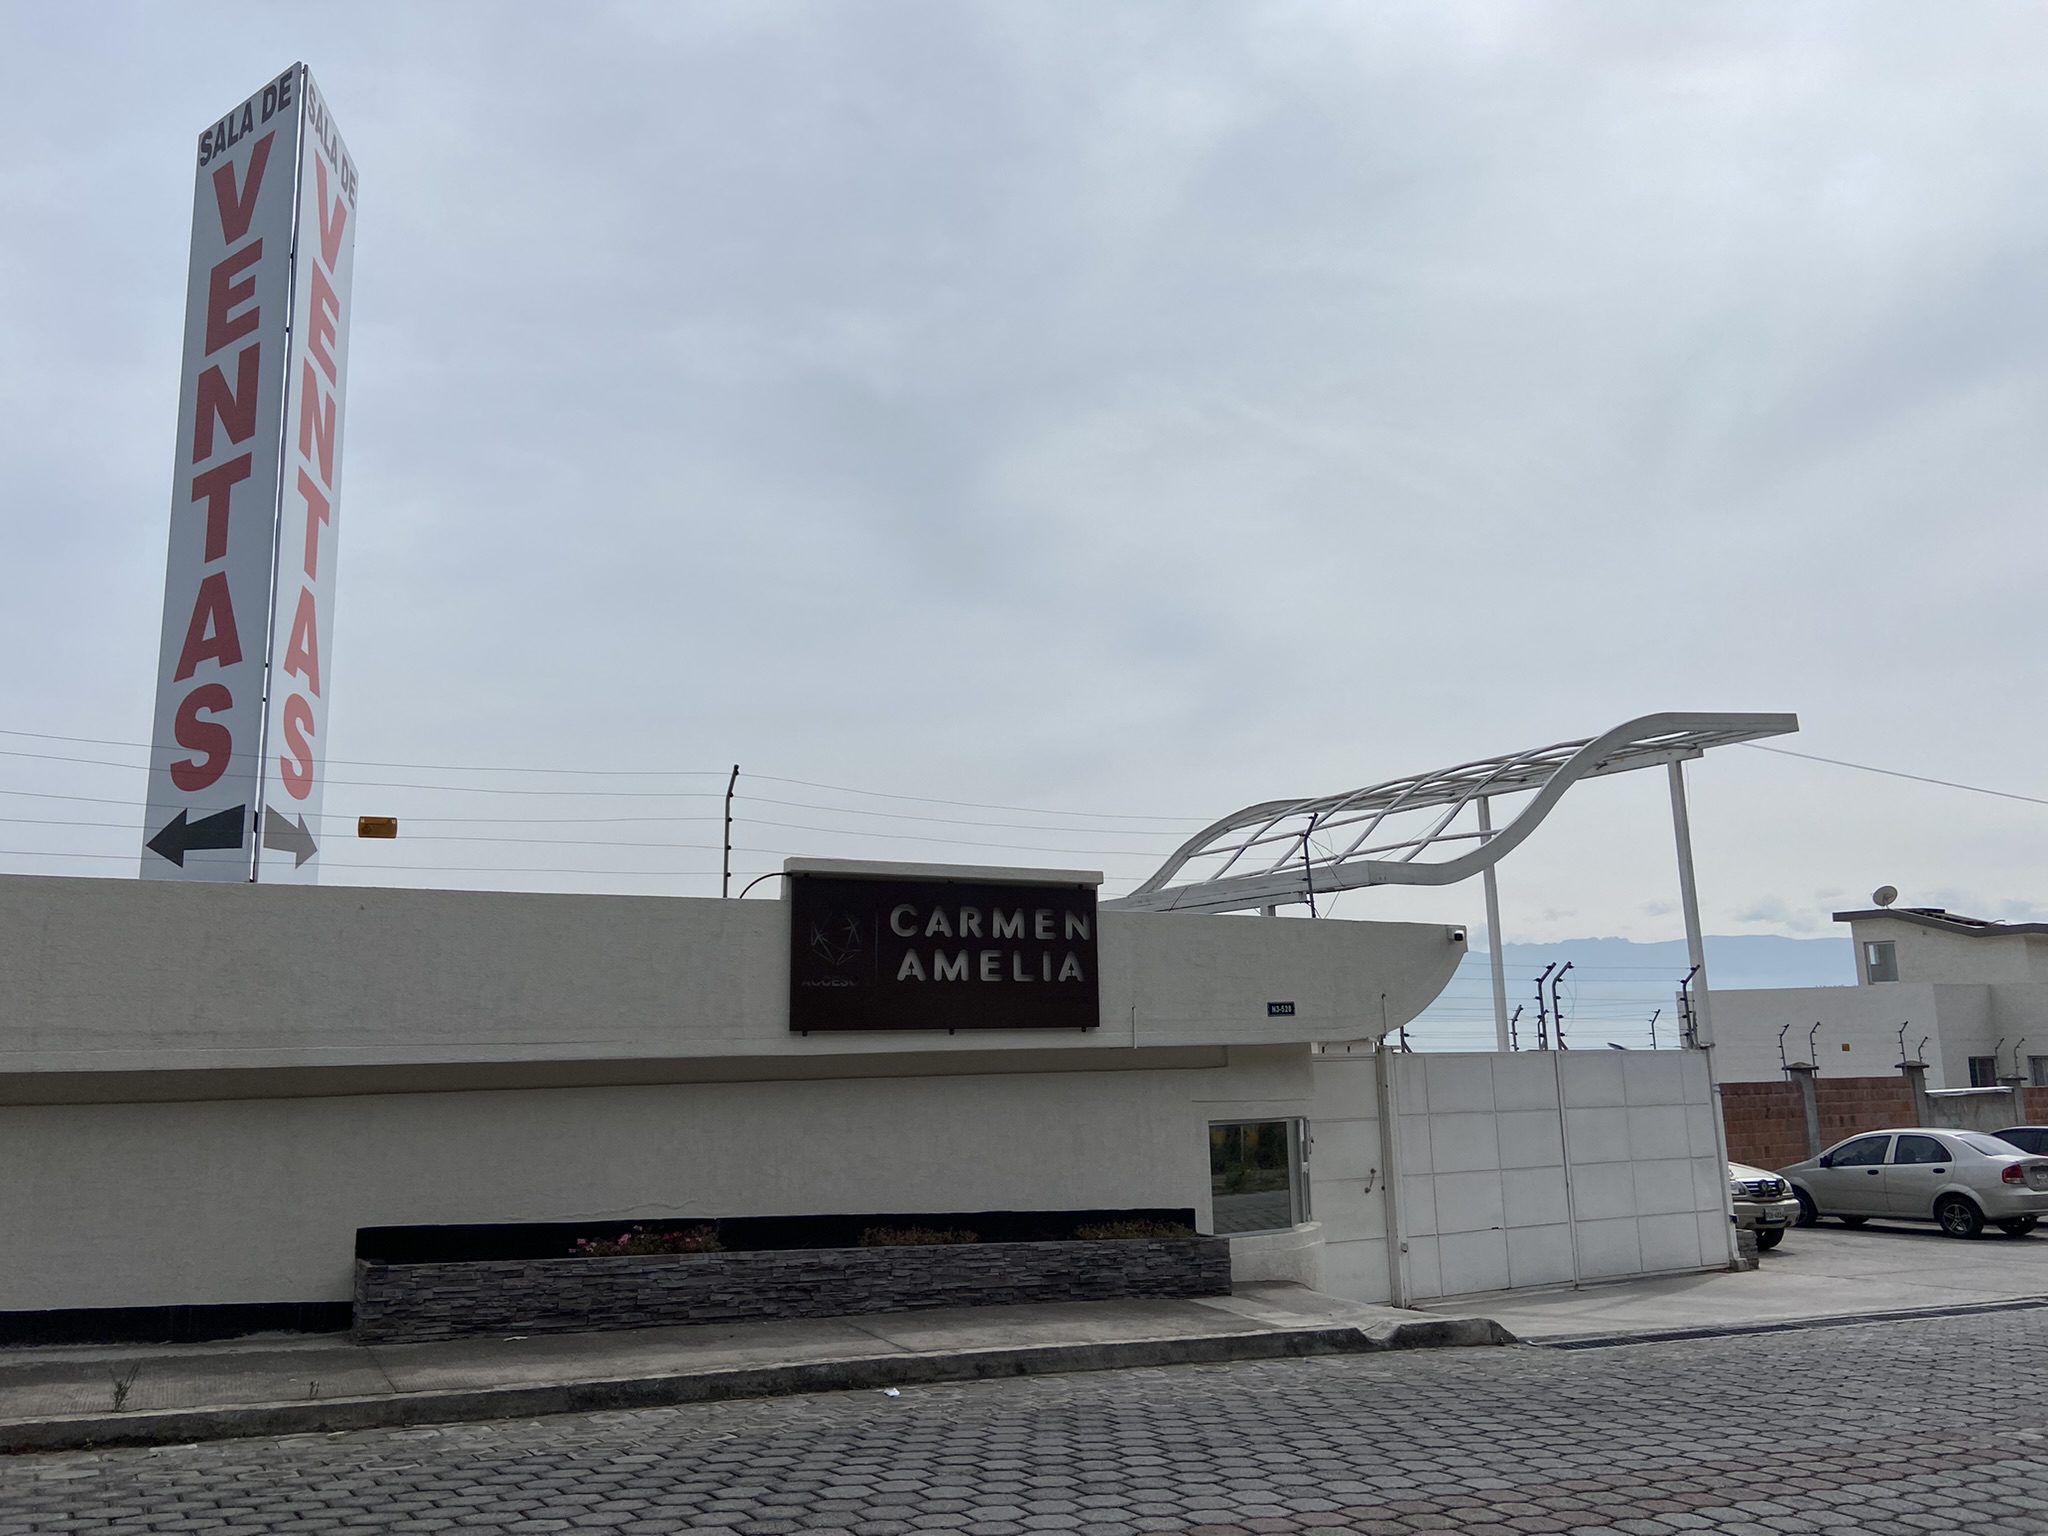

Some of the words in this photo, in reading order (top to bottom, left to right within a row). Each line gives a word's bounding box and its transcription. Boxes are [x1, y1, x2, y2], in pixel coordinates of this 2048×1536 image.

[200, 101, 253, 166] SALA
[262, 70, 293, 124] DE
[307, 84, 338, 174] SALA
[341, 155, 355, 208] DE
[170, 130, 276, 792] VENTAS
[280, 149, 347, 800] VENTAS
[890, 904, 1090, 940] CARMEN
[897, 950, 1083, 982] AMELIA
